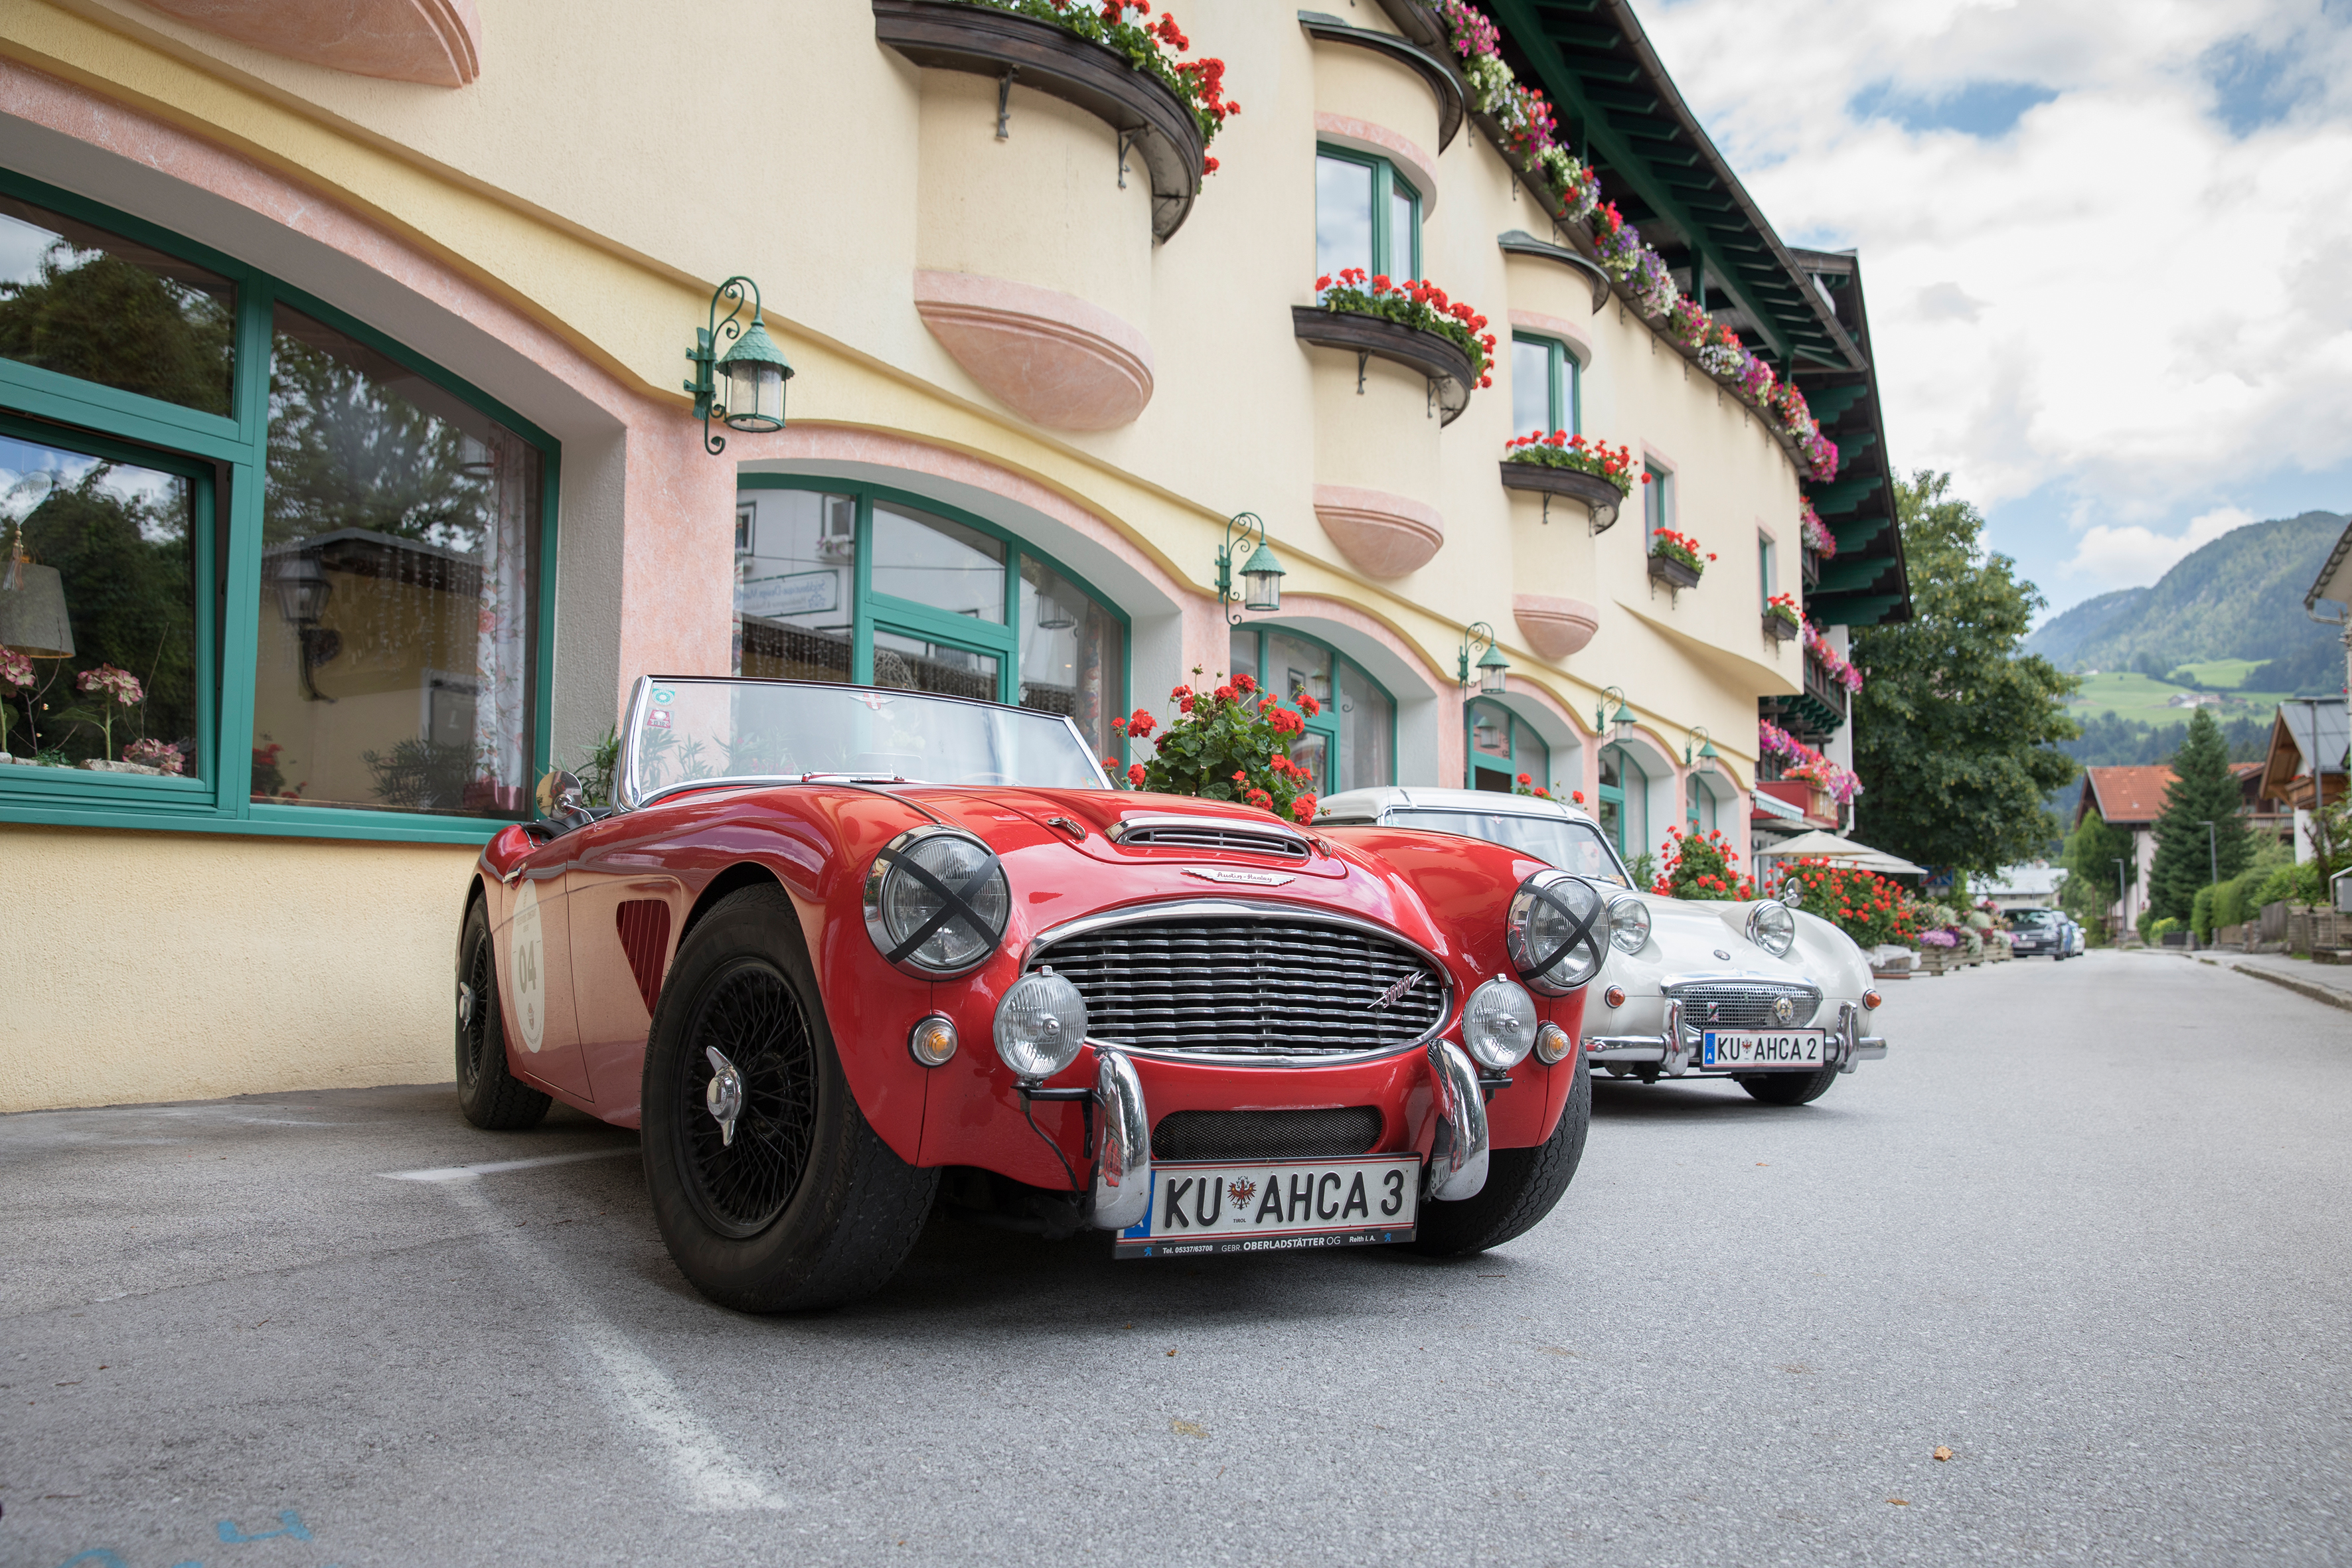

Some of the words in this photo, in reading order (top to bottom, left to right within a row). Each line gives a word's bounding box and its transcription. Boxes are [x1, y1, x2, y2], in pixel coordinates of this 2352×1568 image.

[1217, 872, 1273, 883] Austin-Healey
[519, 940, 536, 994] 04
[1383, 974, 1411, 1009] 3000
[1717, 1037, 1740, 1061] KU
[1754, 1037, 1802, 1061] AHCA
[1807, 1037, 1817, 1060] 2
[1164, 1175, 1223, 1229] KU
[1255, 1170, 1369, 1223] AHCA
[1381, 1168, 1405, 1216] 3
[1243, 1237, 1325, 1251] OBERLADSTÄTTER
[1326, 1236, 1341, 1245] OG
